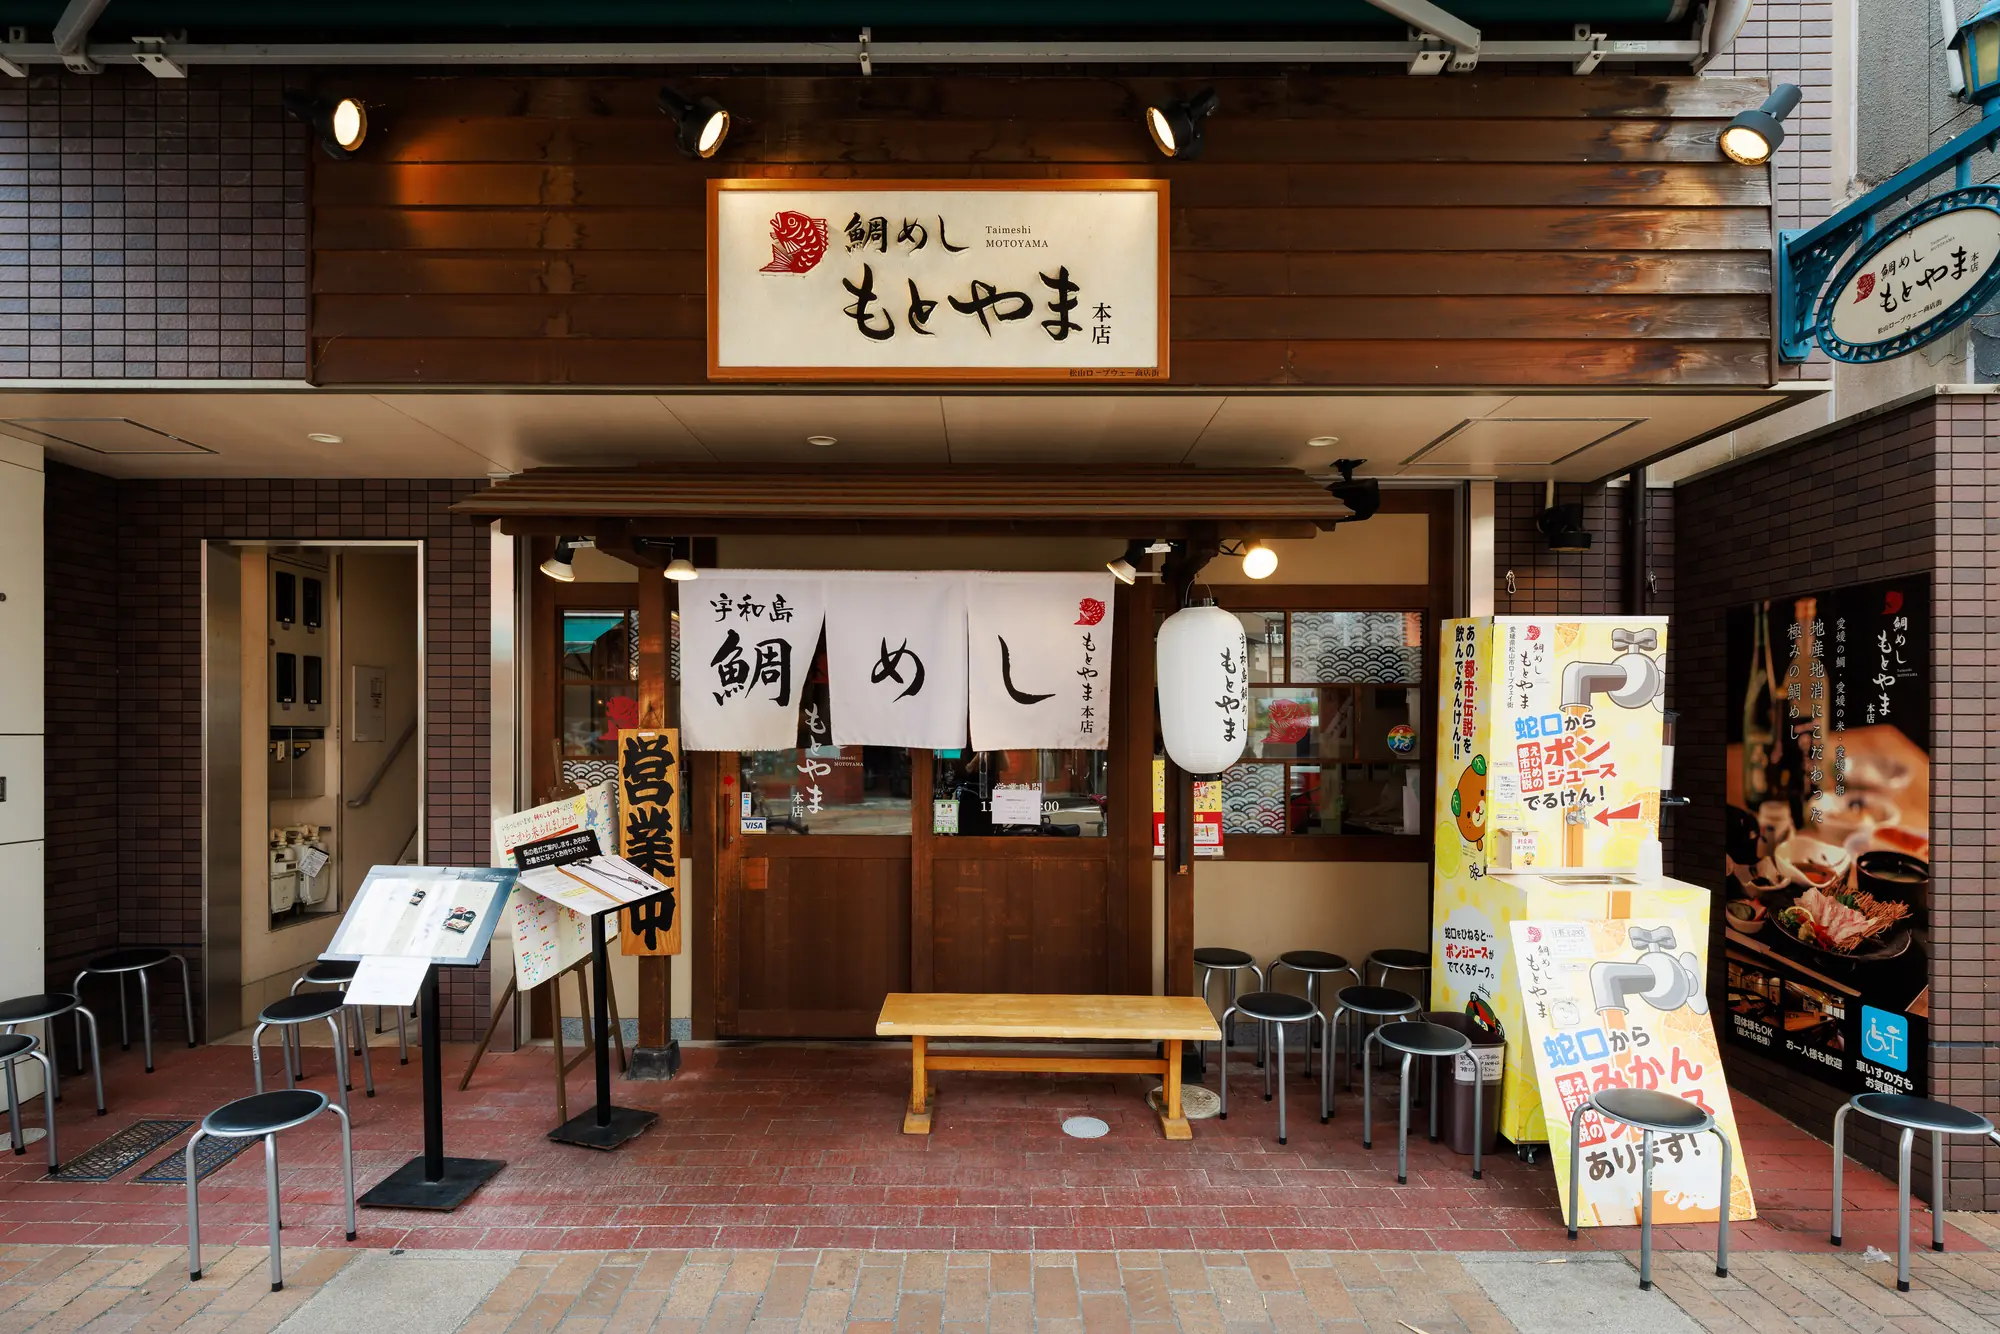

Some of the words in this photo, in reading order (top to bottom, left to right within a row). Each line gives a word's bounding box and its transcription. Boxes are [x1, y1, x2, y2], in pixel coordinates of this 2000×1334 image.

[843, 211, 970, 255] 鯛めし
[985, 225, 1032, 234] Taimeshi
[985, 239, 1049, 248] MOTOYAMA
[1880, 248, 1925, 282] 鯛めし
[1880, 246, 1968, 313] もとやま
[1970, 252, 1980, 273] 本店
[841, 263, 1083, 342] もとやま
[1091, 302, 1113, 345] 本店
[1878, 299, 1943, 335] 松山ロープウェー商店街
[709, 593, 794, 623] 宇和島
[1533, 643, 1545, 675] 鯛めし
[1893, 616, 1909, 664] 鯛めし
[710, 628, 1057, 708] 鯛めし
[1515, 651, 1533, 709] もとやま
[1786, 622, 1802, 740] 極みの鯛めし
[1873, 629, 1896, 717] もとやま
[1215, 647, 1240, 742] もとやま
[1462, 625, 1476, 754] あの都市伝説を
[1514, 713, 1596, 740] 蛇口から
[1809, 618, 1826, 823] 地産地消にこだわった
[1866, 703, 1876, 724] 本店
[796, 703, 832, 814] もとやま
[1518, 747, 1533, 790] 都市伝説
[1530, 746, 1543, 788] えひめの
[1544, 735, 1611, 767] ポン
[1547, 763, 1618, 787] ジュース
[791, 792, 804, 818] 本店
[622, 734, 676, 951] 営業中
[1445, 943, 1494, 960] ポンジュースが
[1538, 945, 1552, 980] 鯛めし
[1526, 954, 1547, 1018] もとやま
[1543, 1025, 1651, 1069] 蛇口から
[1734, 1014, 1774, 1038] 団体様もOK
[1591, 1047, 1703, 1092] みかん
[1785, 1040, 1843, 1070] お一人様も歓迎
[1855, 1059, 1914, 1091] 車いすの方も
